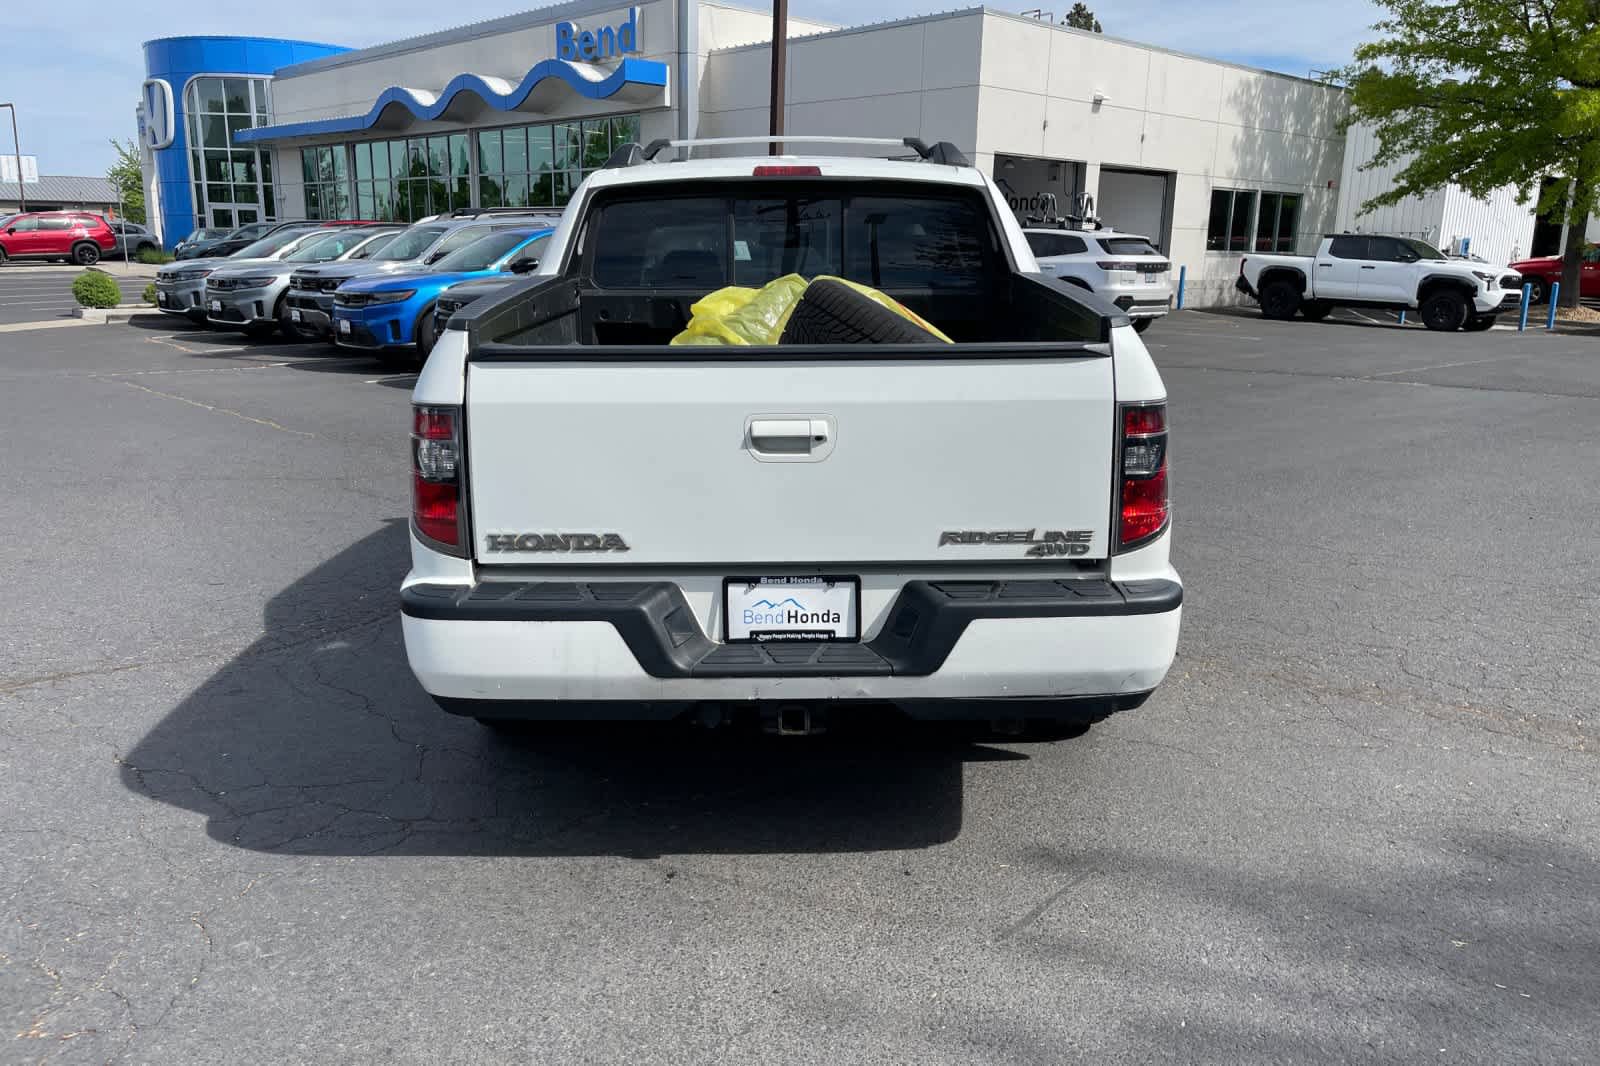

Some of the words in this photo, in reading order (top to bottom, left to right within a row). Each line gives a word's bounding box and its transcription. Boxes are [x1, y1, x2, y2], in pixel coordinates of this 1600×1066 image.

[556, 7, 637, 60] Bend
[485, 533, 631, 553] HONDA
[938, 528, 1094, 547] RIDGELINE
[1024, 543, 1090, 557] 4WD
